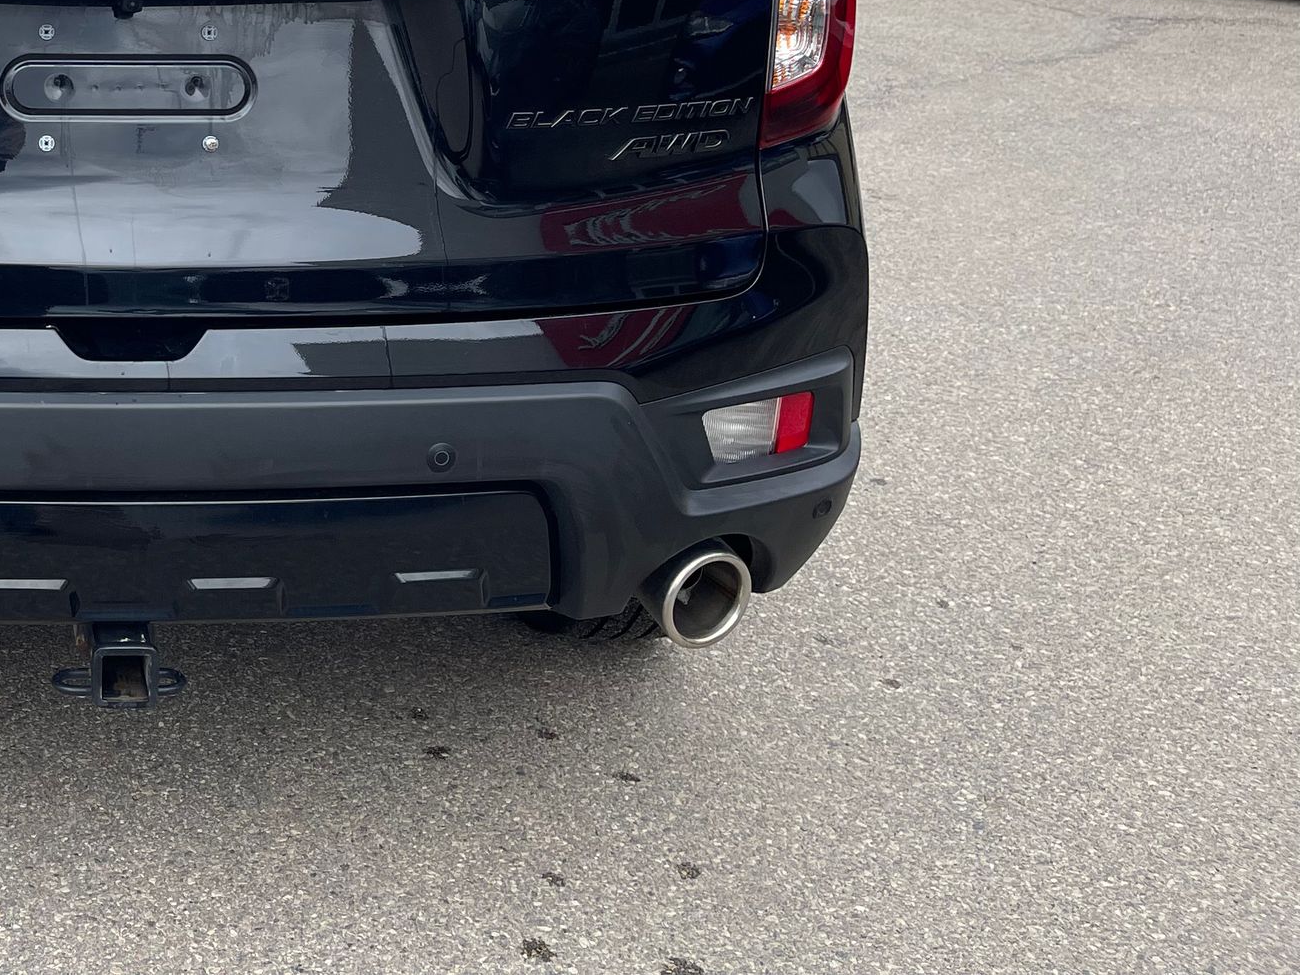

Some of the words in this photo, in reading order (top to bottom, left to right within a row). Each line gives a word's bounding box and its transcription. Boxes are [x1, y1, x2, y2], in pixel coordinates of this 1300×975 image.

[506, 106, 628, 130] BLACK
[630, 97, 754, 123] EDITION
[607, 129, 731, 161] AWD
